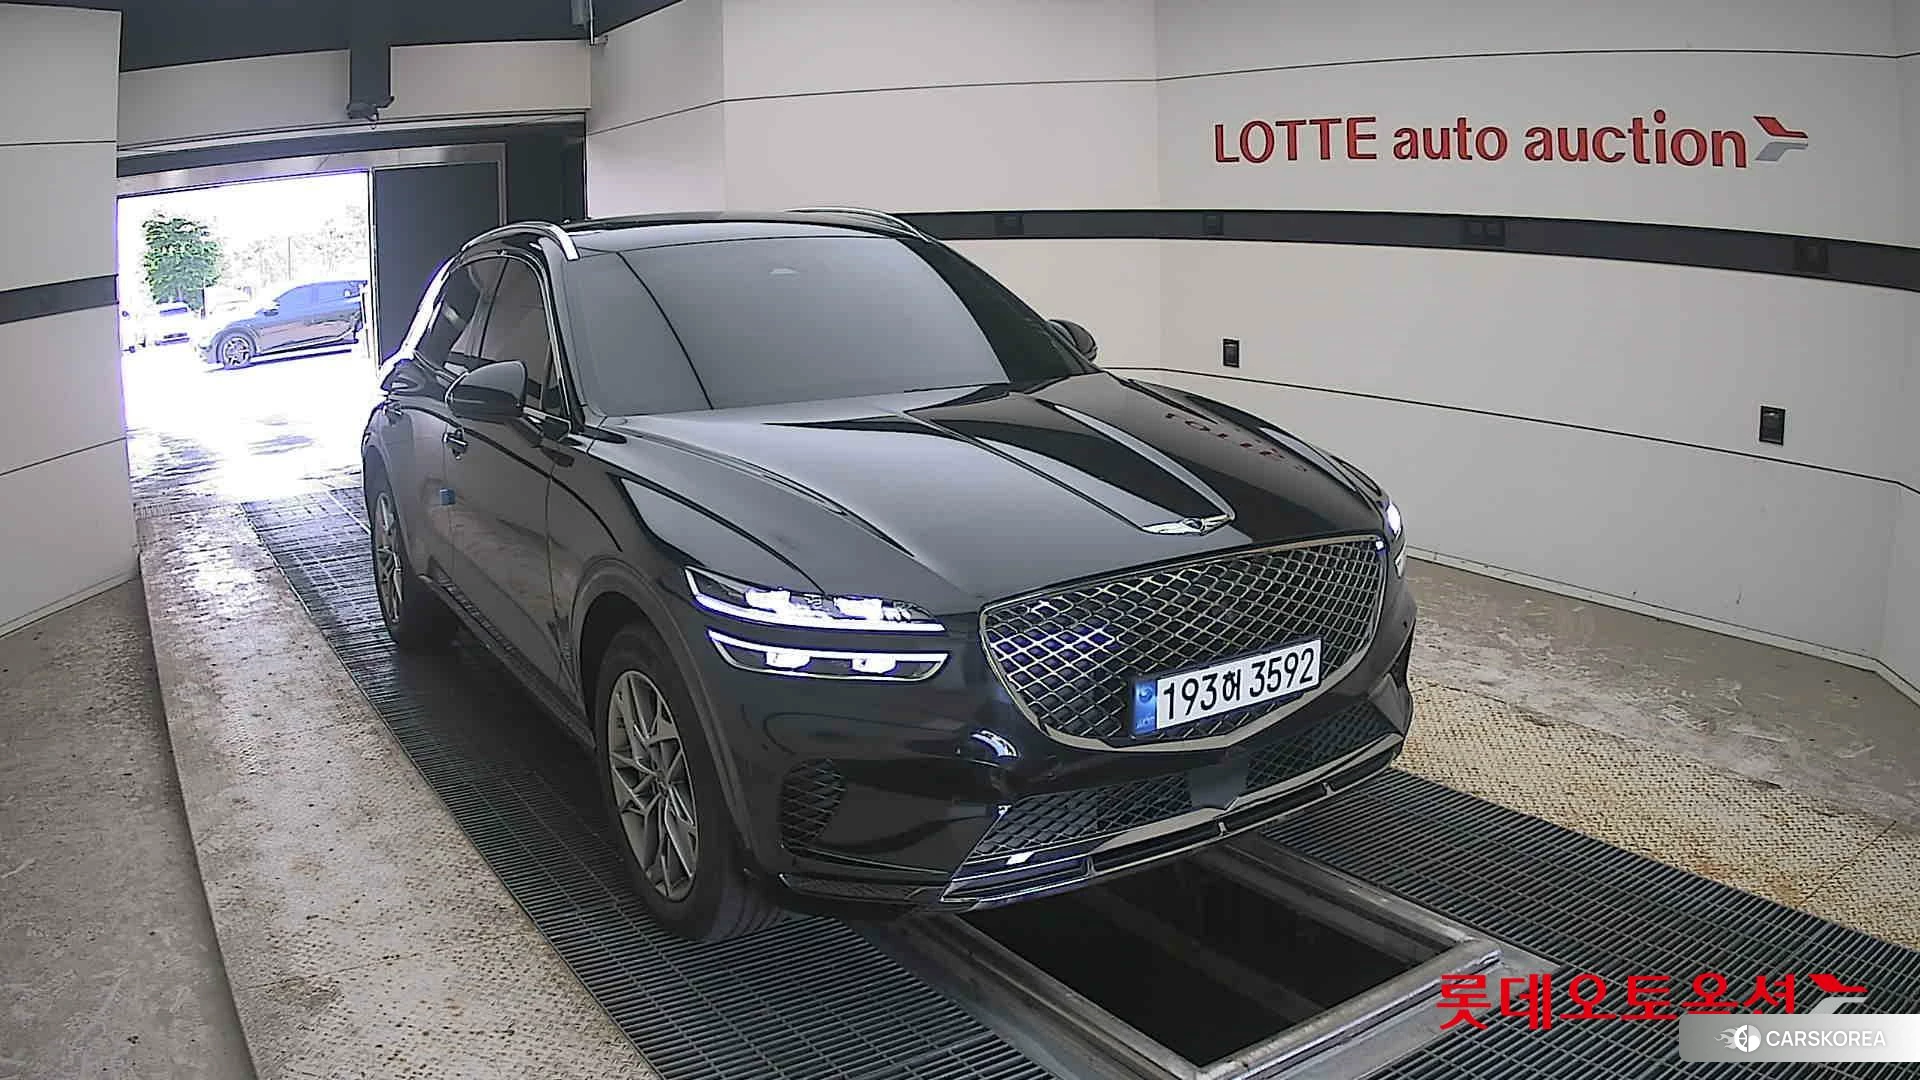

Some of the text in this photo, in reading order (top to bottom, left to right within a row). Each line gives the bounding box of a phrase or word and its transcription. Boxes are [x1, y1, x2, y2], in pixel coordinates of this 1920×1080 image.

[1214, 109, 1747, 168] LOTTE auto auction
[1163, 647, 1314, 720] 193허 3592
